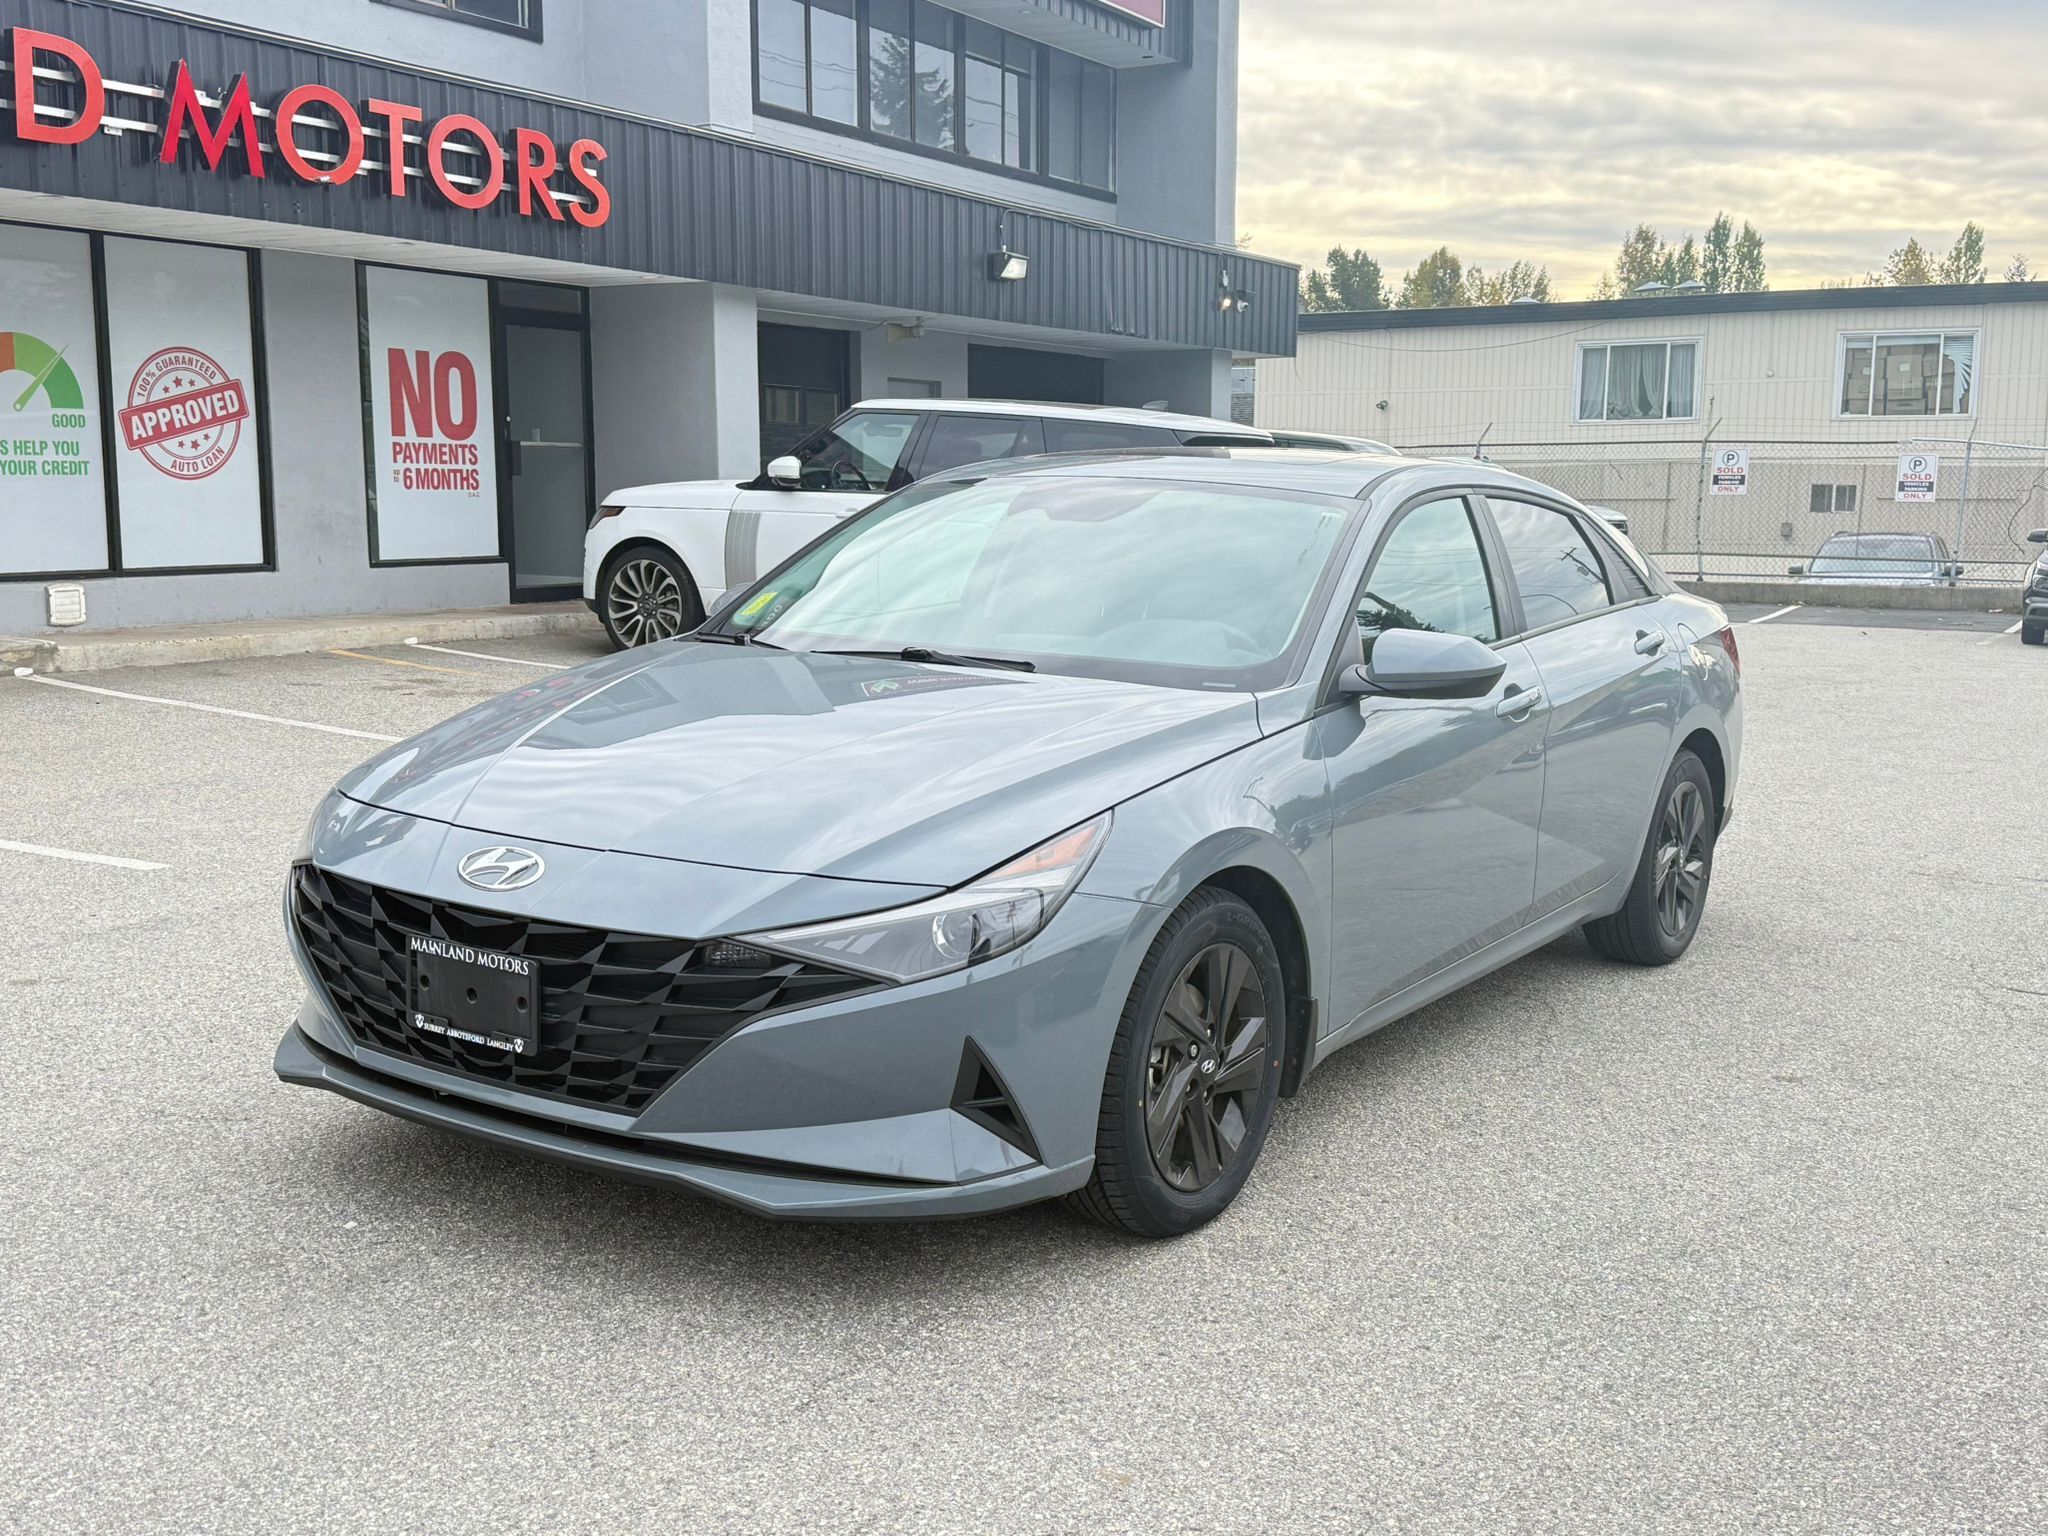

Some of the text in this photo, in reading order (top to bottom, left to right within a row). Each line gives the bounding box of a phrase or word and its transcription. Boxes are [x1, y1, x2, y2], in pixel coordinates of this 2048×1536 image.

[158, 57, 611, 229] MOTORS
[137, 355, 217, 398] 100% GUARANTEED
[387, 347, 478, 441] NO
[51, 413, 86, 429] GOOD
[131, 389, 240, 441] APPROVED
[13, 439, 48, 456] HELP
[52, 440, 80, 456] YOU
[170, 446, 225, 473] AUTO LOAN
[392, 441, 478, 466] PAYMENTS
[0, 459, 91, 476] YOUR CREDIT
[403, 467, 480, 491] 6 MONTHS
[1716, 466, 1744, 474] SOLD
[411, 937, 529, 976] MAINLAND MOTORS
[423, 1022, 515, 1052] SURREY ABBOTSFORD LANGLEY
